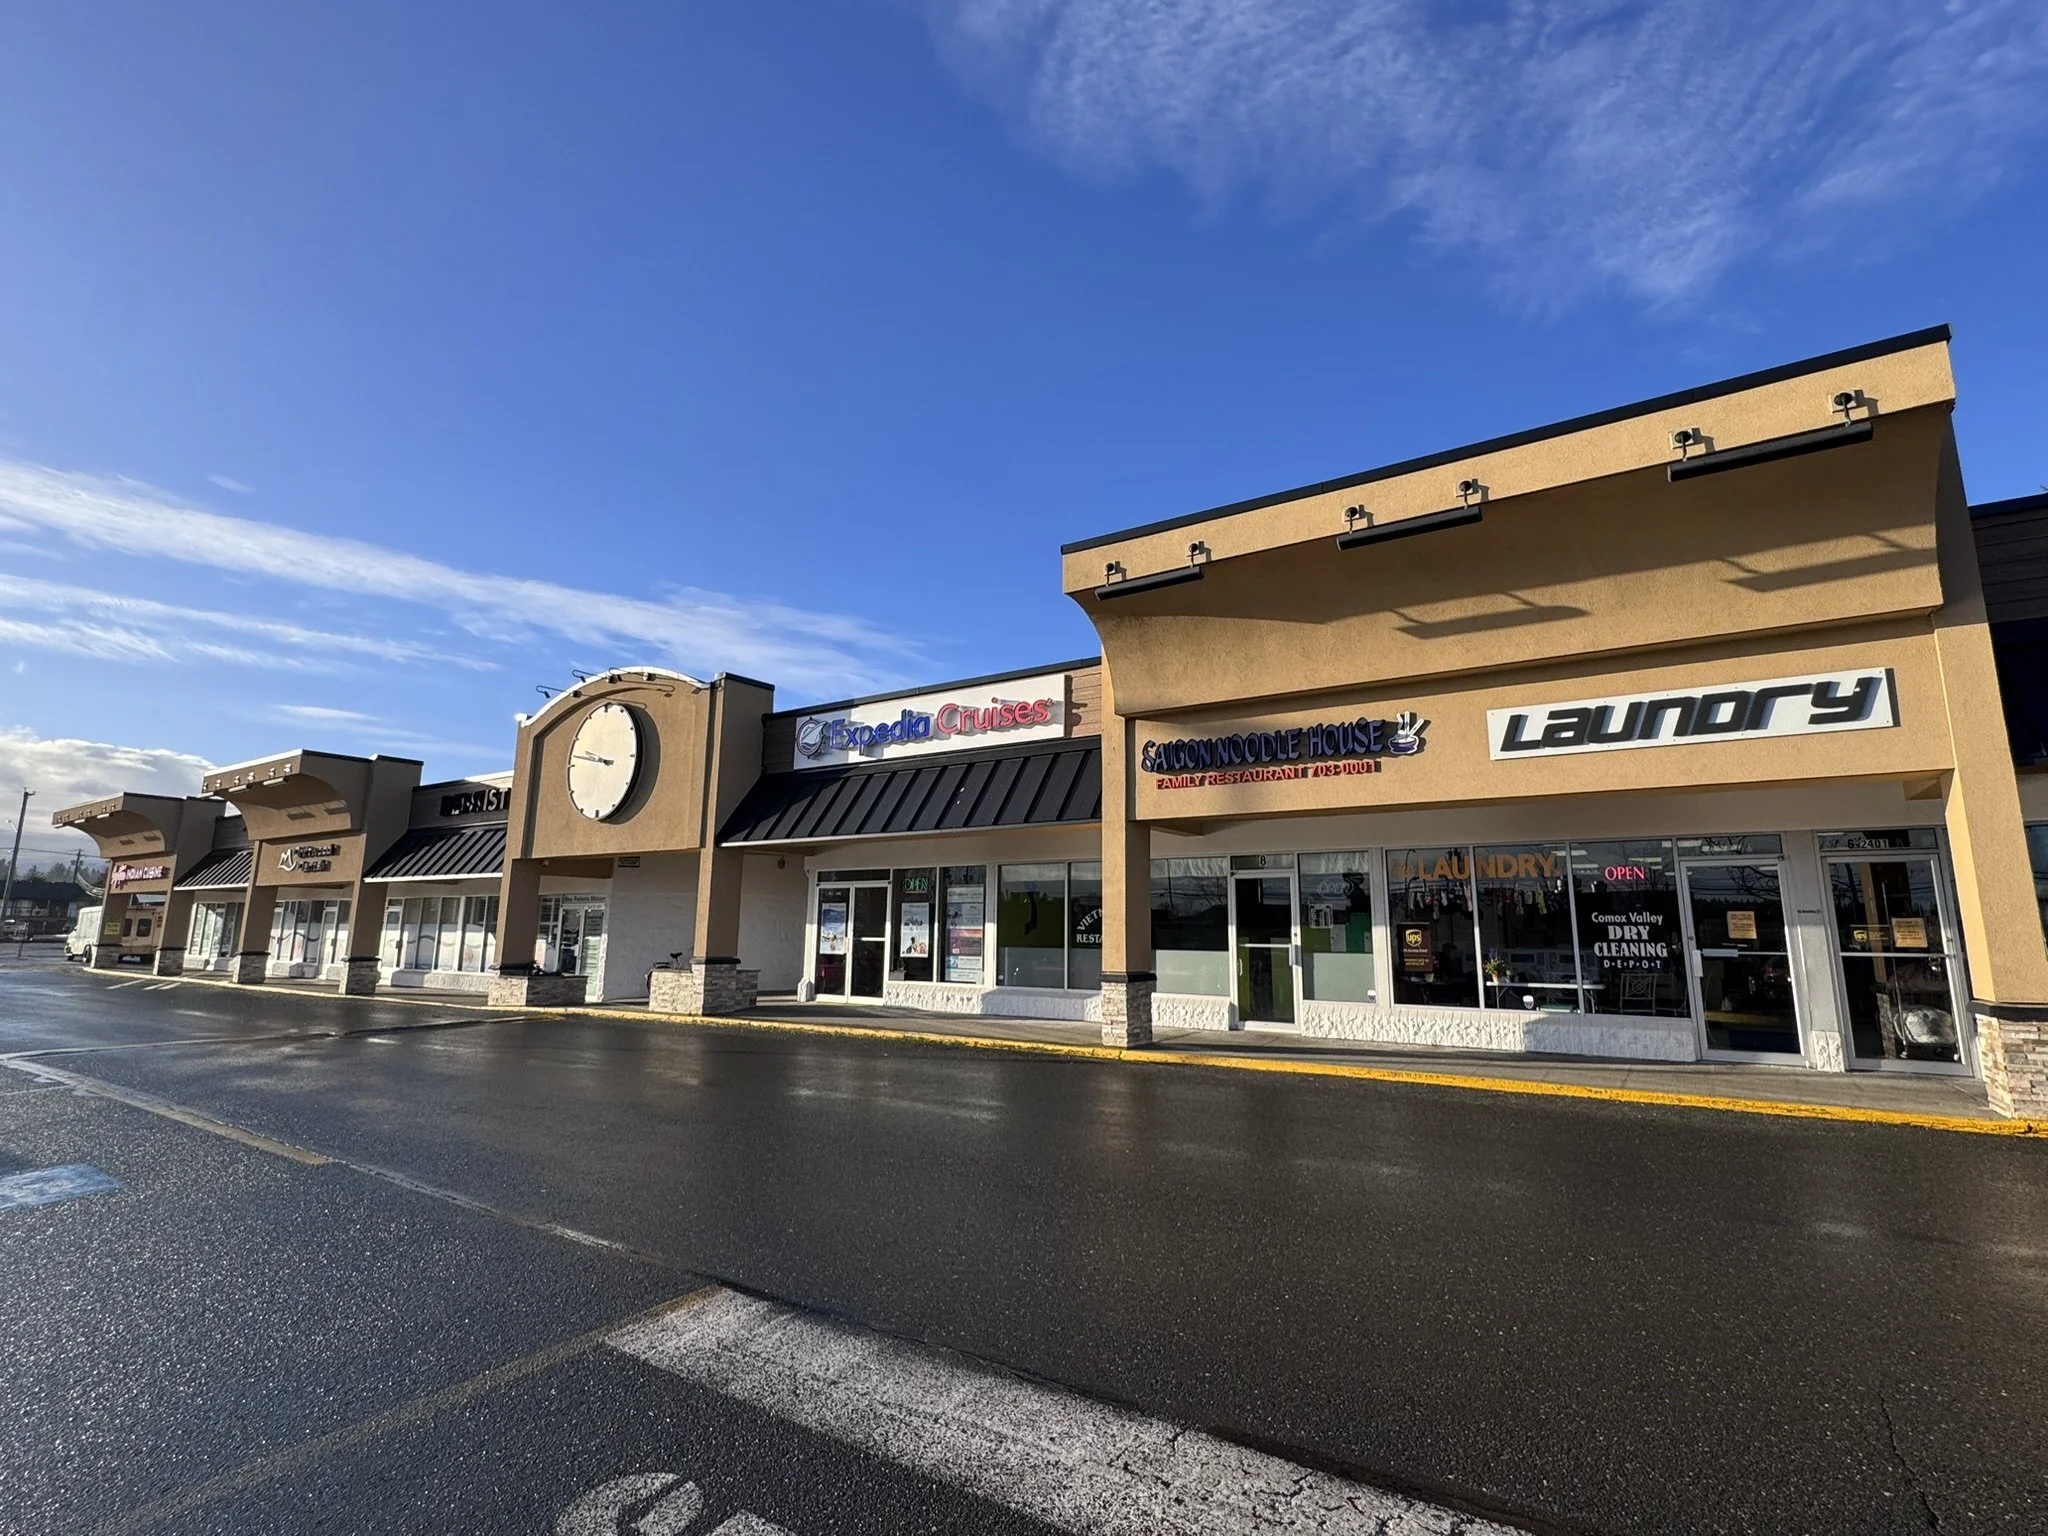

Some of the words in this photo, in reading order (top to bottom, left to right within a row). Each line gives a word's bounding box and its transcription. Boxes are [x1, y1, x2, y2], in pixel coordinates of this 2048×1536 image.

[830, 709, 931, 756] Expedia
[936, 697, 1050, 734] Cruises
[1141, 738, 1213, 773] SAIGON
[1216, 728, 1303, 767] NOODLE
[1309, 717, 1386, 759] HOUSE
[1156, 775, 1203, 790] FAMILY
[1206, 765, 1306, 786] RESTAURANT
[1308, 760, 1378, 777] 703-0001
[1260, 855, 1266, 866] 8
[1605, 866, 1646, 881] OPEN
[1591, 911, 1628, 923] Comox
[1629, 911, 1664, 926] Valley
[1607, 925, 1650, 940] DRY
[1593, 942, 1669, 957] CLEANING
